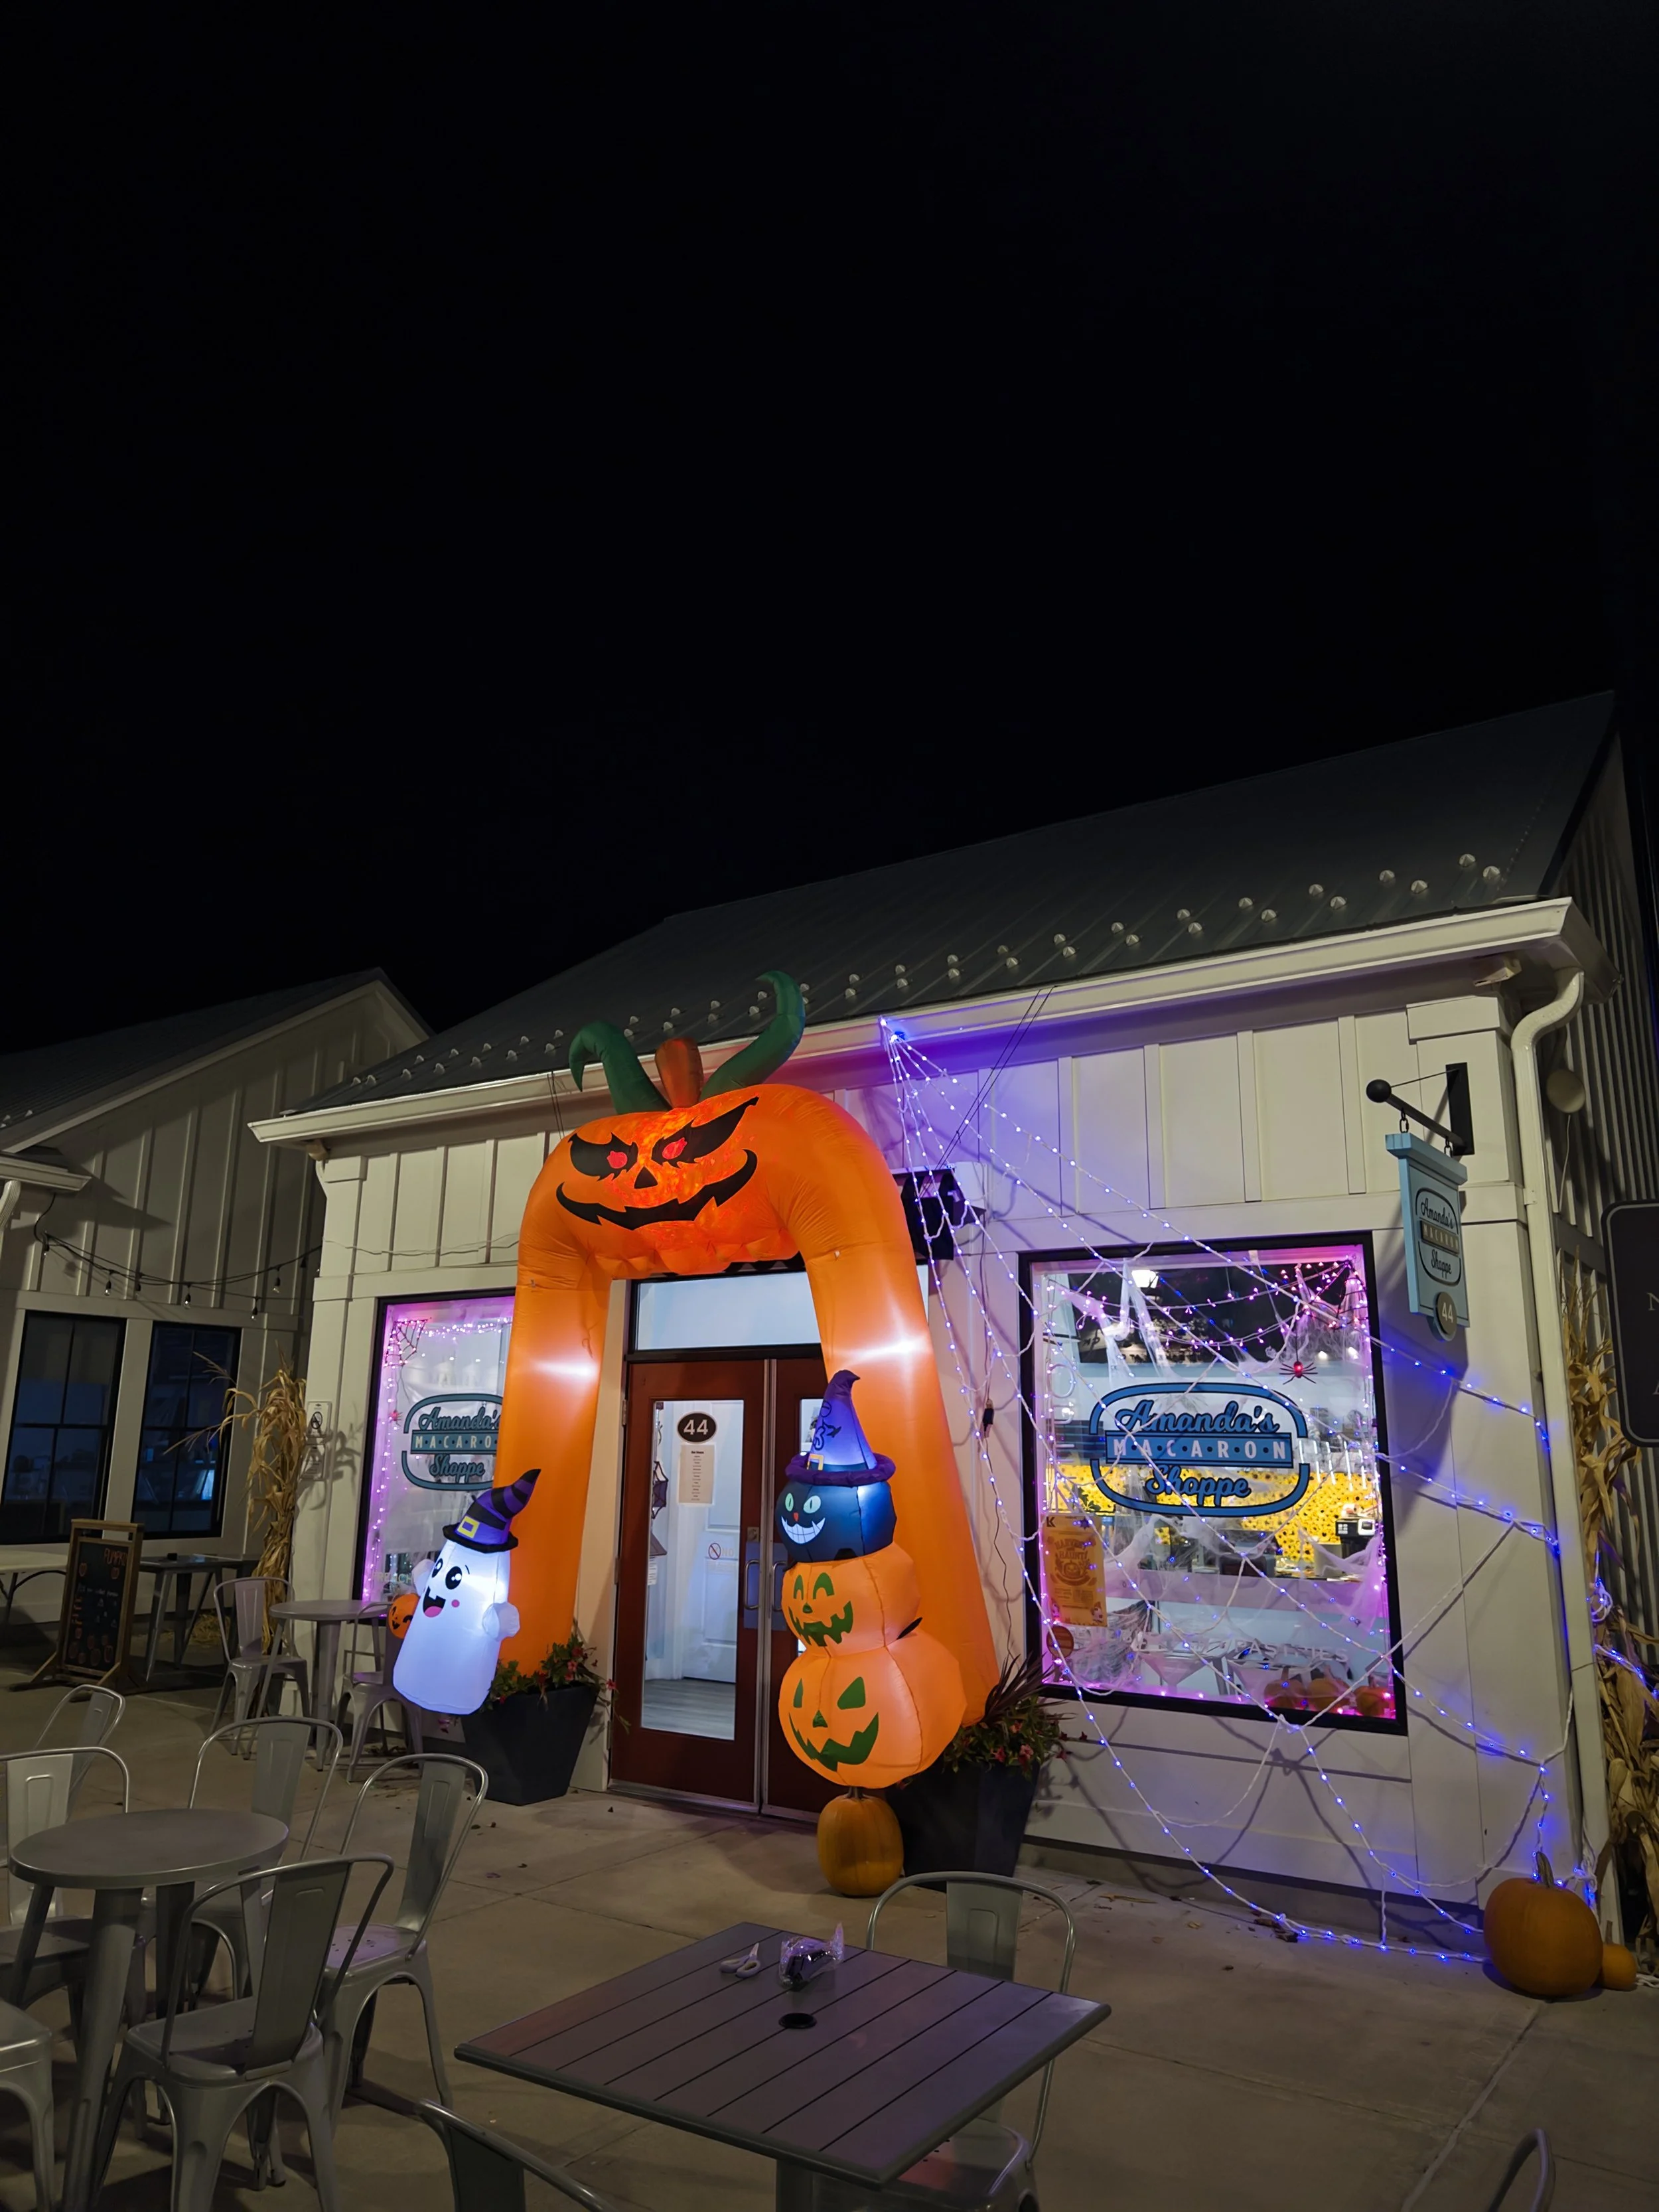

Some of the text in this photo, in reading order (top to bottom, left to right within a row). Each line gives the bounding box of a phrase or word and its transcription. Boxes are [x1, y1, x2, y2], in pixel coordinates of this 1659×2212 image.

[1421, 1197, 1454, 1229] Amanda's
[1431, 1248, 1452, 1280] Shoppe
[1441, 1301, 1453, 1323] 44
[684, 1419, 709, 1436] 44
[1114, 1399, 1281, 1434] Amanda's
[429, 1453, 486, 1483] Shoppe
[1145, 1464, 1252, 1507] Shoppe
